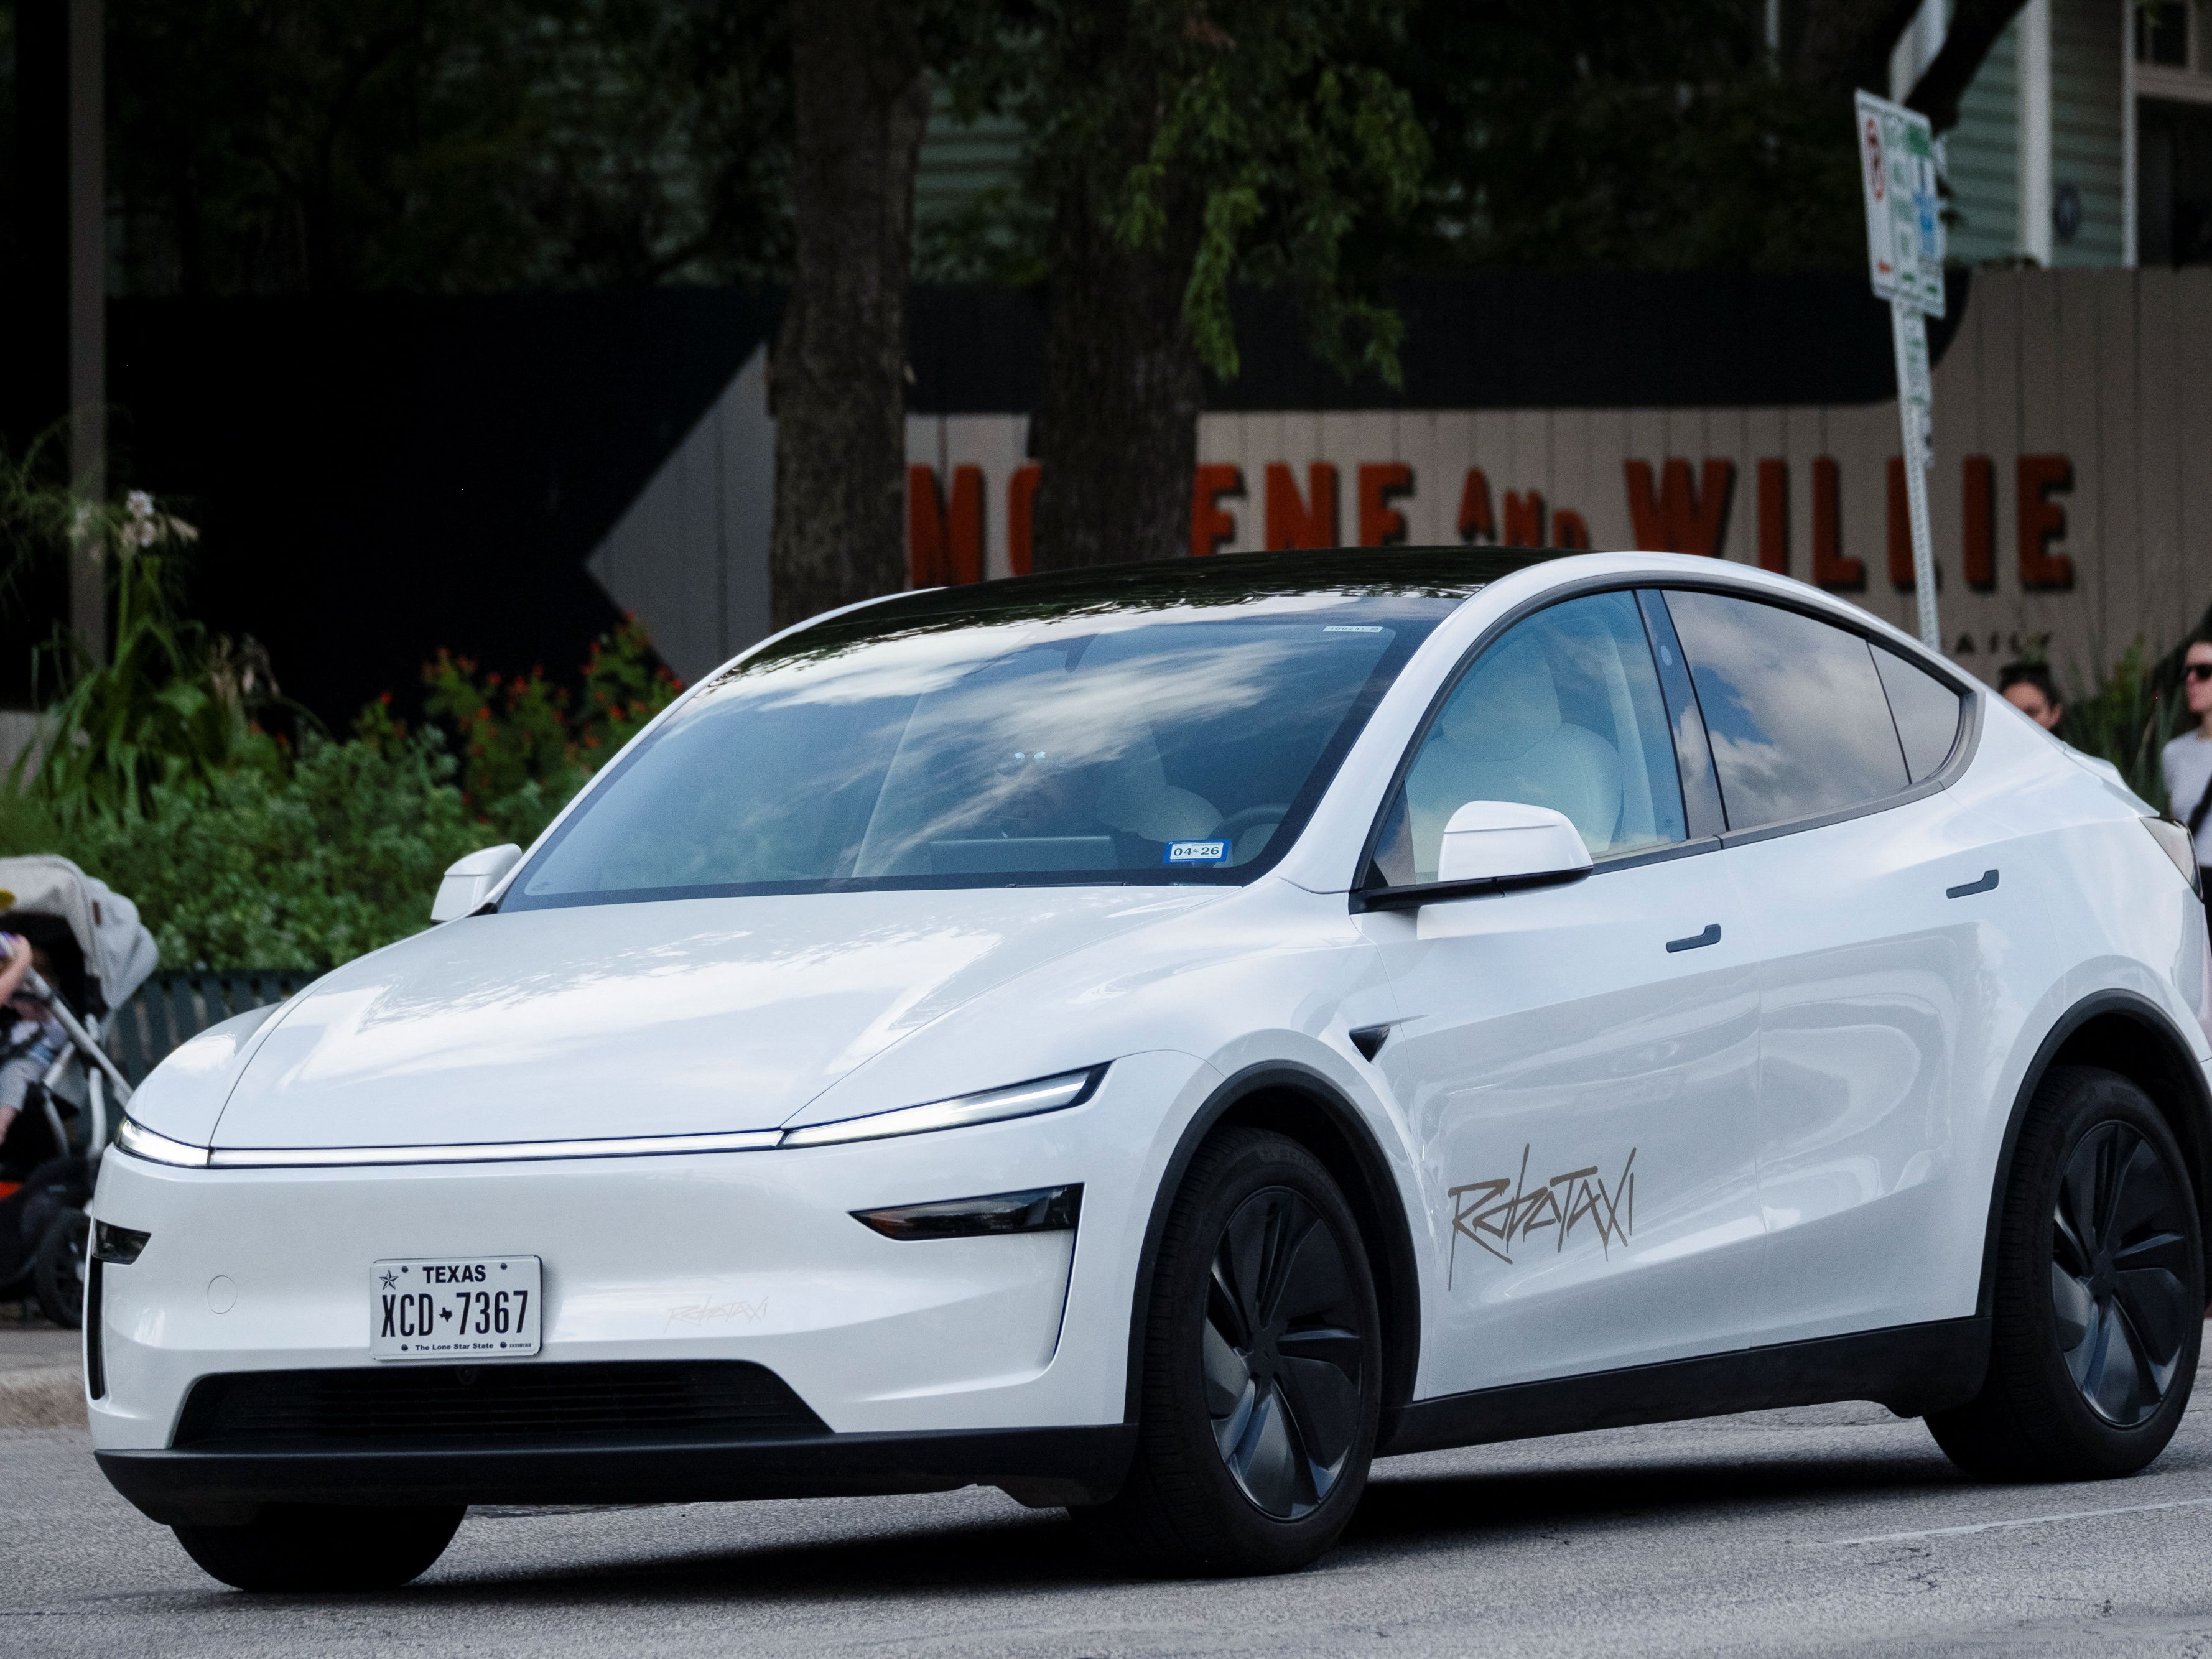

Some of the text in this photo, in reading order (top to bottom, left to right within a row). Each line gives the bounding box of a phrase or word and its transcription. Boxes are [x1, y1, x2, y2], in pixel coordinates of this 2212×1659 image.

[1173, 847, 1220, 856] 04 26
[422, 1264, 486, 1283] TEXAS
[381, 1290, 529, 1337] XCD 7367
